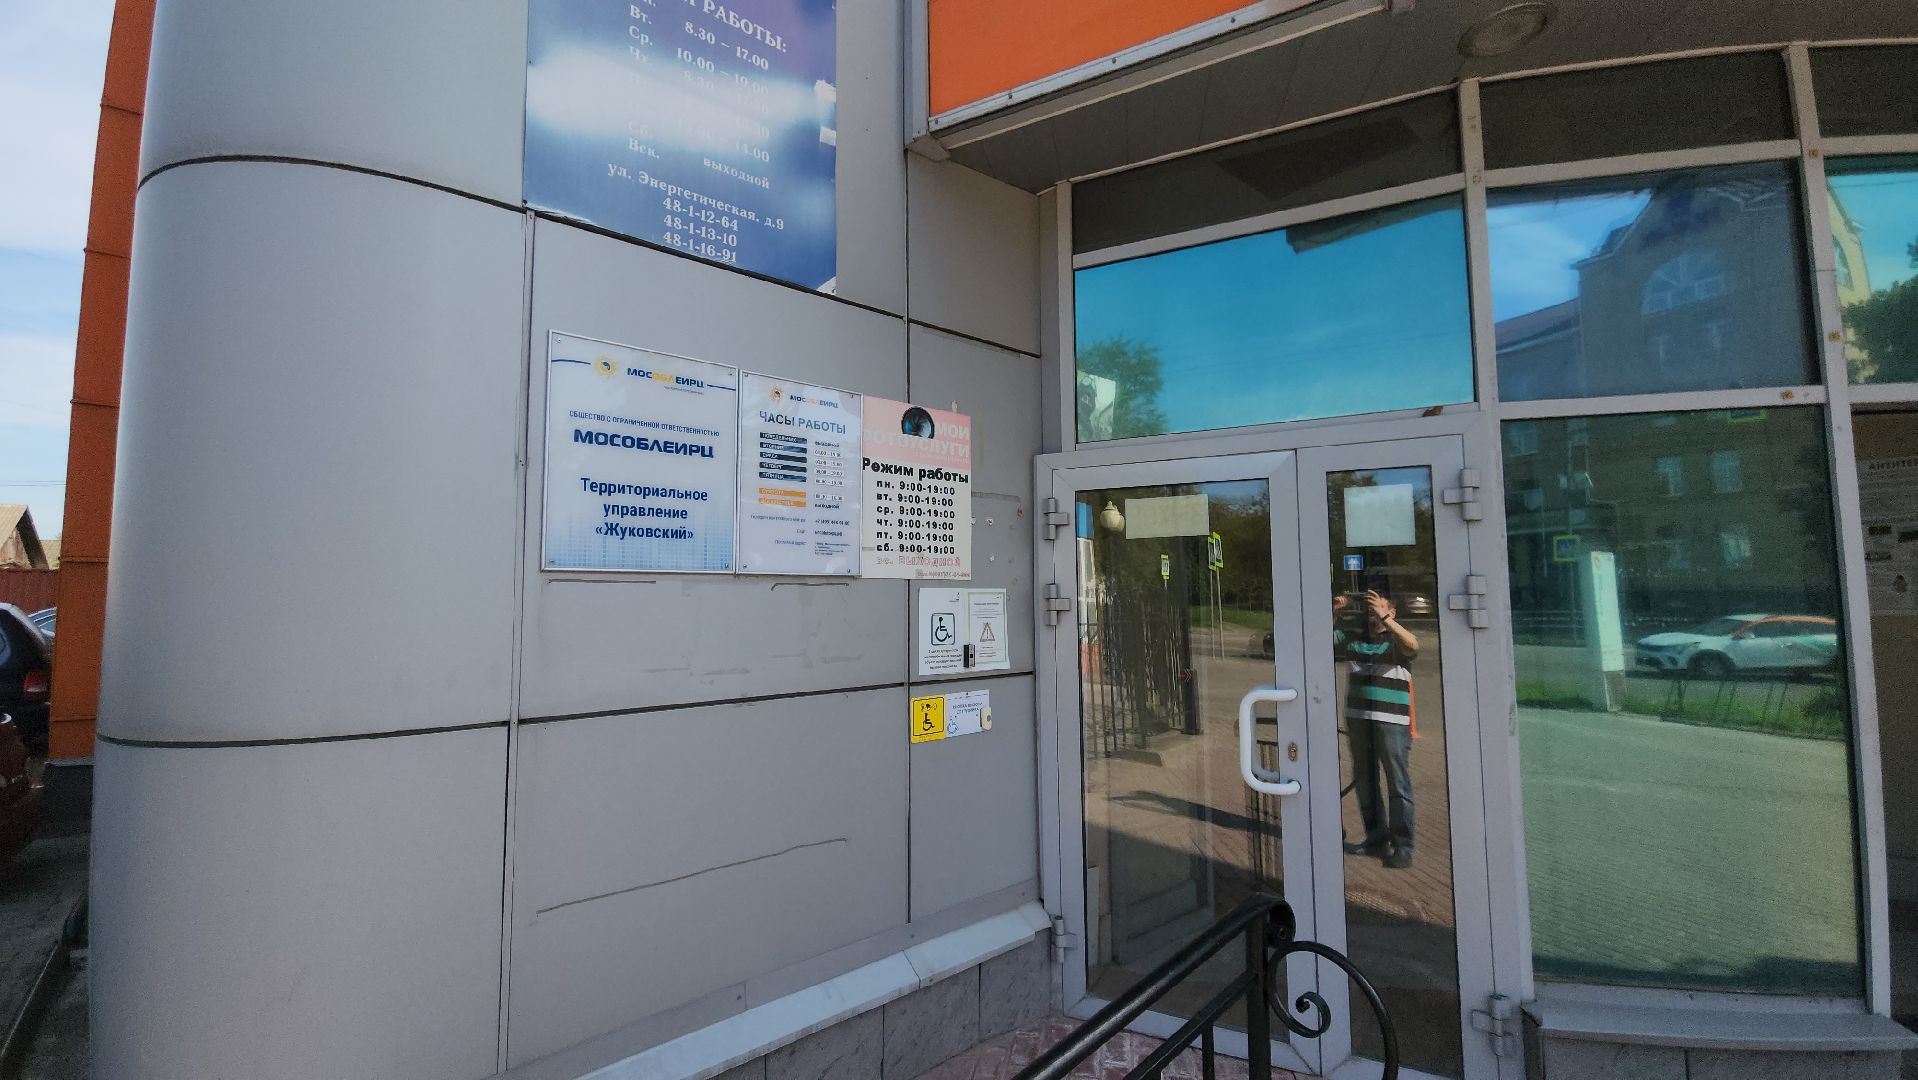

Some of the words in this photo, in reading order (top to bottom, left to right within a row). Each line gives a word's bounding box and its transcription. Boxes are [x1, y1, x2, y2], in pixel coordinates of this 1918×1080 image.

[629, 4, 653, 24] Вт.
[684, 21, 716, 45] 8.30
[735, 46, 769, 70] 17.00
[702, 0, 787, 53] РАБОТЫ:
[628, 25, 653, 46] Ср.
[677, 47, 715, 73] 10.00
[628, 137, 660, 159] Вск.
[703, 157, 770, 189] выходной
[607, 163, 632, 180] ул.
[764, 216, 784, 231] д.9
[662, 198, 739, 232] 48-1-12-64
[663, 214, 737, 247] 48-1-13-10
[663, 231, 737, 263] 48-1-16-91
[627, 367, 705, 388] МОСОБЛЕИРЦ
[569, 410, 605, 423] ОБЩЕСТВО
[612, 416, 660, 429] ОГРАНИЧЕННОЙ
[661, 422, 720, 437] ОТВЕТСТВЕННОСТЬЮ
[759, 410, 795, 426] ЧАСЫ
[798, 418, 846, 434] РАБОТЫ
[573, 429, 714, 458] МОСОБЛЕИРЦ
[862, 457, 914, 477] Режим
[918, 468, 969, 484] работы
[580, 477, 708, 501] Территориальное
[876, 480, 895, 489] пн.
[899, 481, 955, 495] 9:00-19:00
[876, 493, 893, 502] вт.
[897, 493, 954, 507] 9:00-19:00
[603, 503, 688, 519] управление
[876, 505, 894, 515] ср.
[899, 505, 955, 519] 9:00-19:00
[595, 522, 694, 540] «Жуковский»
[876, 518, 893, 527] чт.
[897, 518, 954, 531] 9:00-19:00
[876, 531, 893, 540] пт.
[897, 531, 954, 543] 9:00-19:00
[876, 543, 894, 552] сб.
[899, 544, 955, 555] 9:00-19:00
